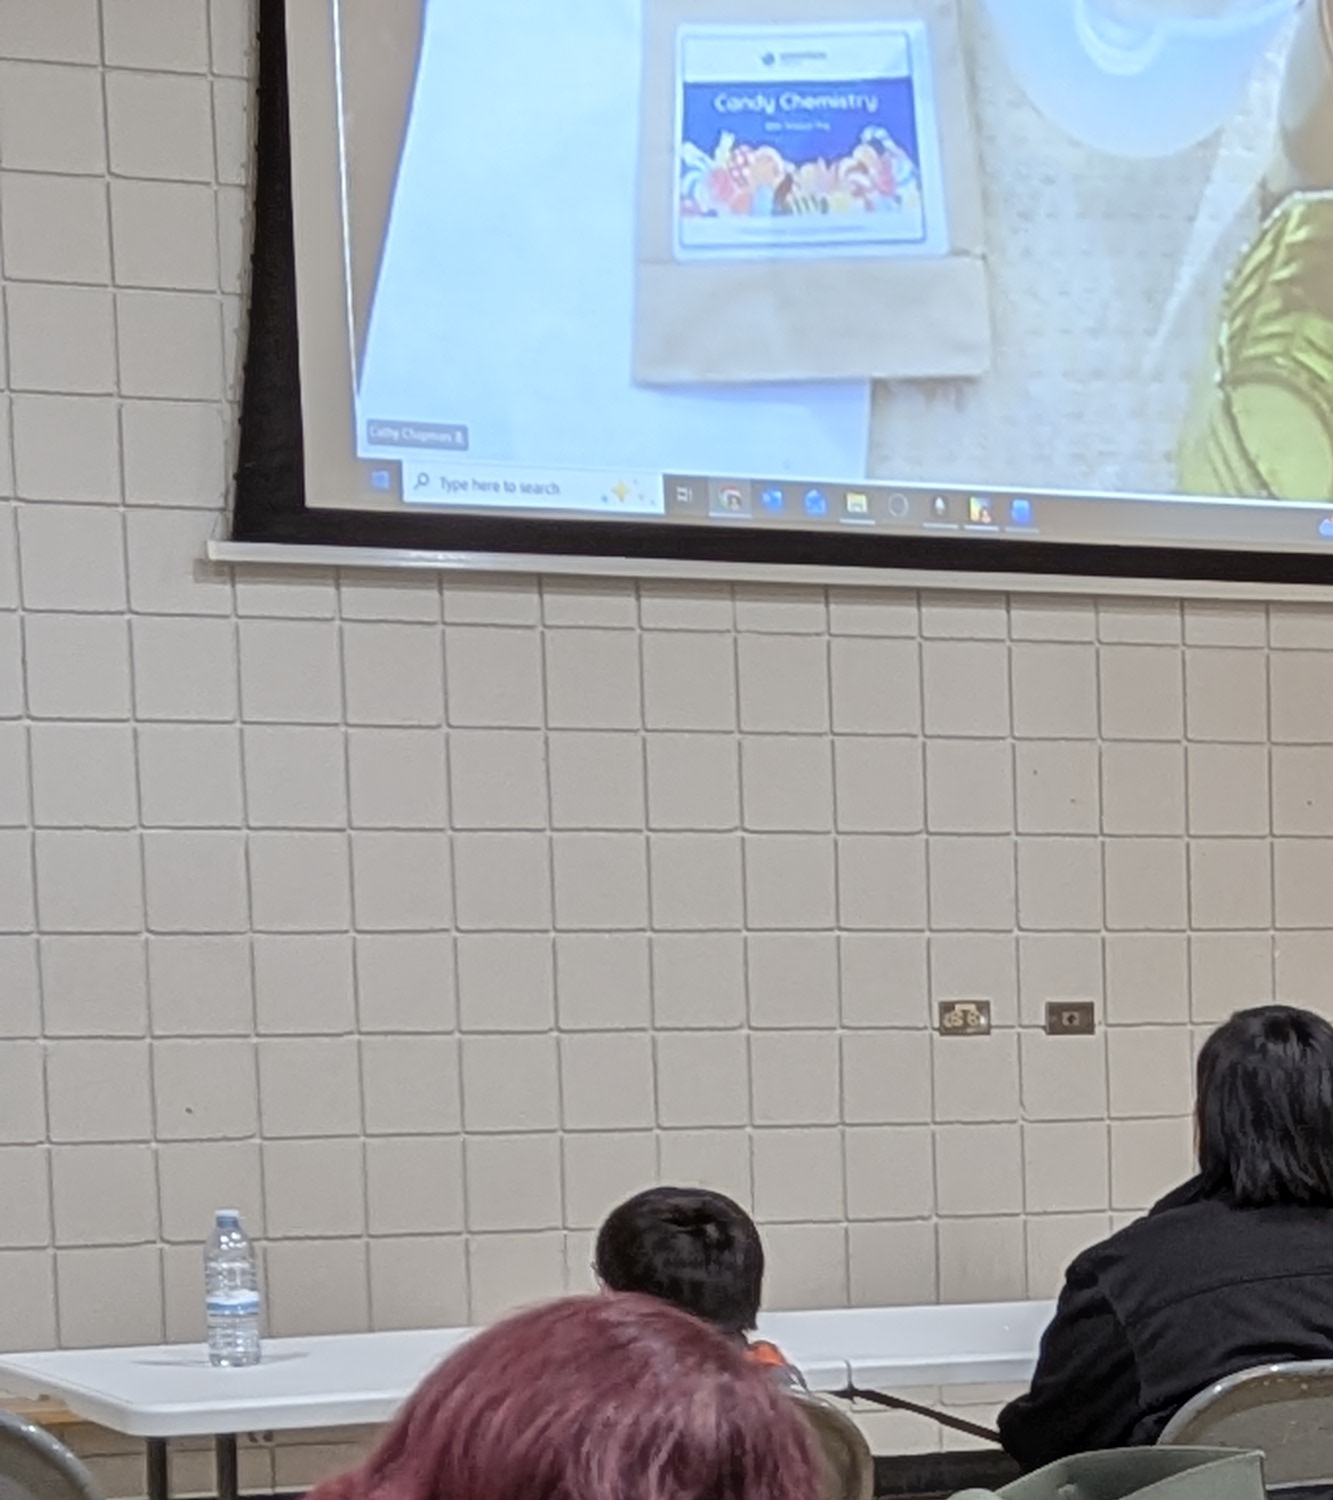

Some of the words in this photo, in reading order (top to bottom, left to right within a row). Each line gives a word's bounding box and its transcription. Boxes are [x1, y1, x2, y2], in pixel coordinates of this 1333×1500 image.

[714, 93, 776, 115] Candy
[779, 92, 879, 113] Chemistry
[440, 476, 469, 494] Type
[471, 478, 501, 493] here
[503, 480, 517, 493] to
[520, 482, 561, 496] search
